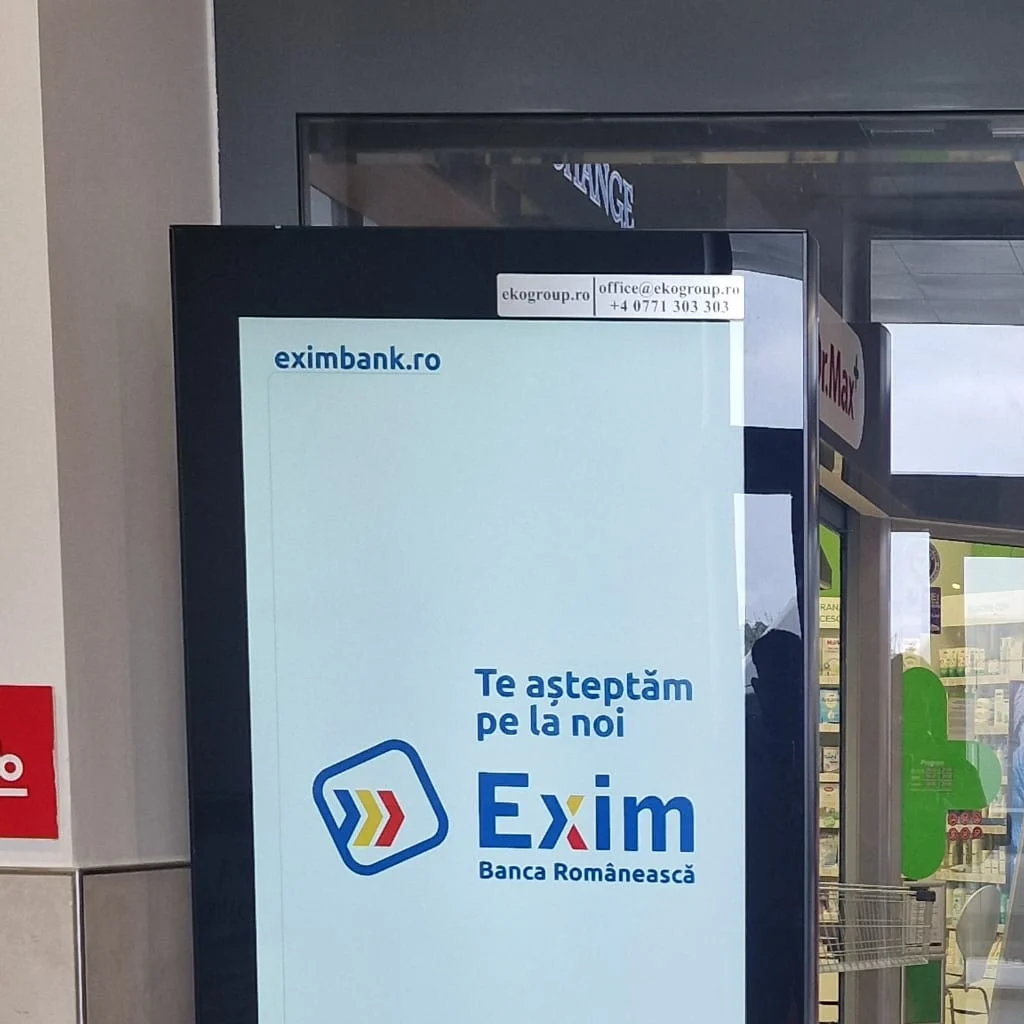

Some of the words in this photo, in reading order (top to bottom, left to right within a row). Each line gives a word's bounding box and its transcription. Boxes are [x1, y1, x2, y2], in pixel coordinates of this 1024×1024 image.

[501, 287, 591, 304] ekogroup.ro
[599, 281, 741, 298] office@ekogroup.ro
[610, 300, 629, 313] +4
[633, 300, 667, 313] 0771
[673, 300, 699, 314] 303
[703, 300, 730, 314] 303
[273, 345, 442, 371] eximbank.ro
[474, 668, 516, 698] Te
[526, 669, 693, 706] așteptăm
[477, 709, 520, 741] pe
[530, 704, 560, 736] la
[572, 706, 625, 738] noi
[477, 771, 695, 853] Exim
[479, 861, 546, 881] Banca
[554, 862, 696, 885] Românească
